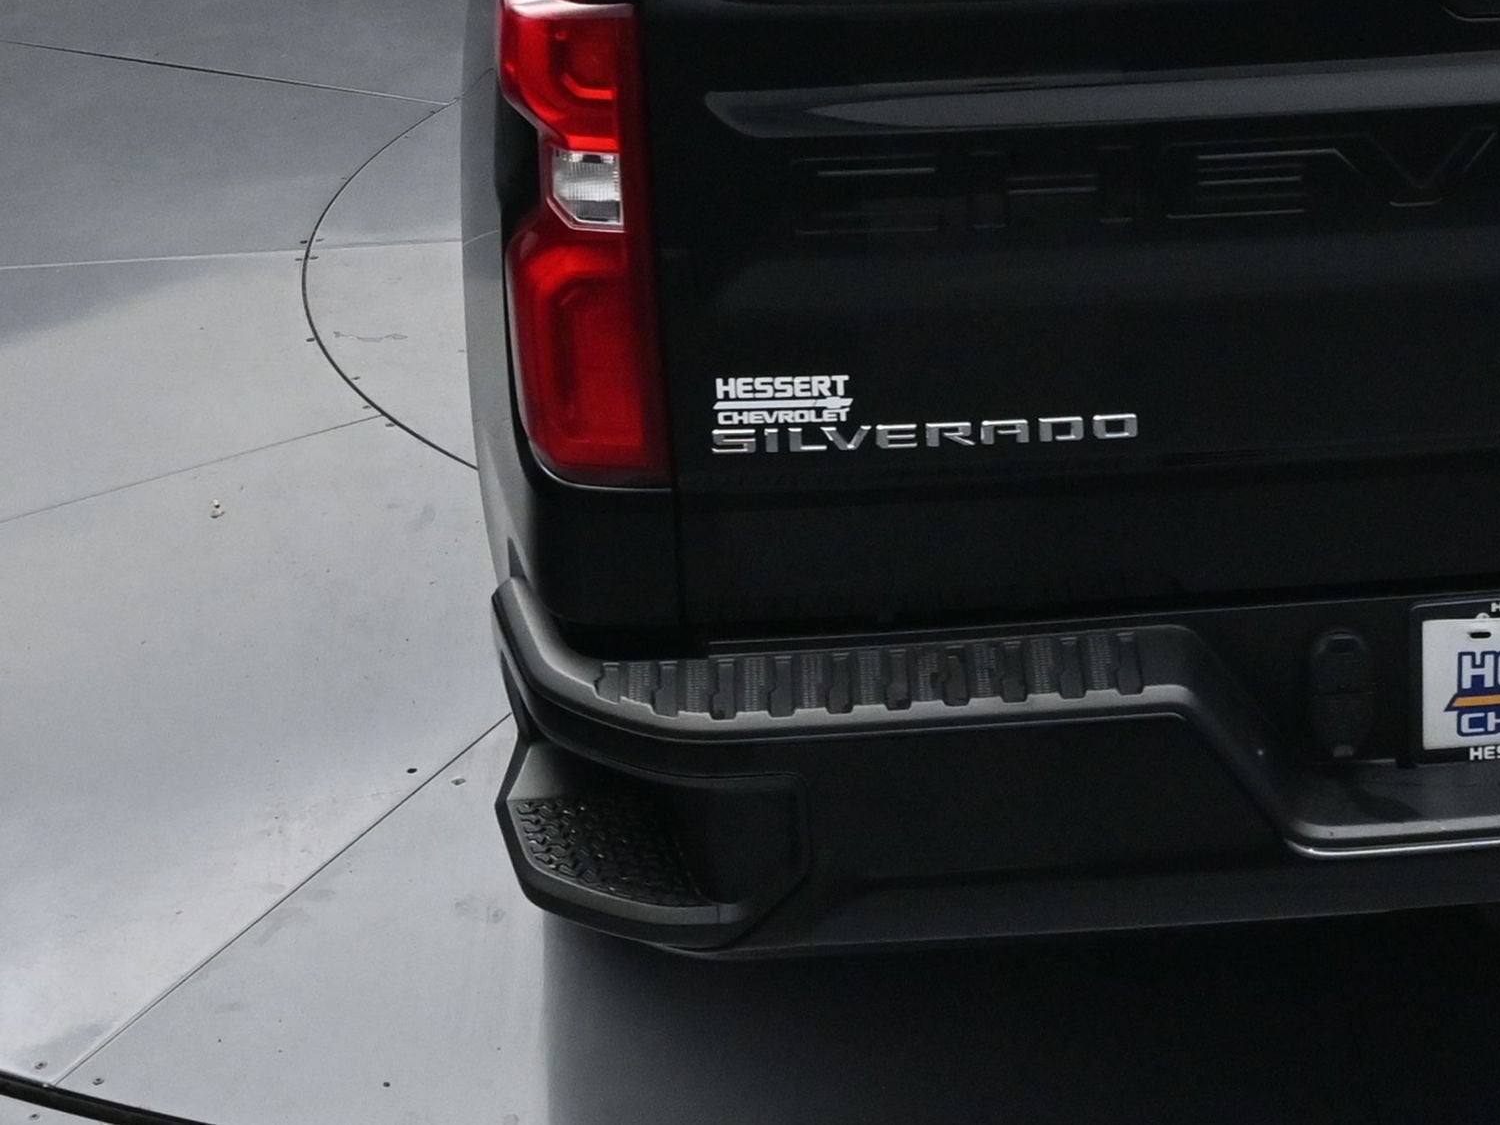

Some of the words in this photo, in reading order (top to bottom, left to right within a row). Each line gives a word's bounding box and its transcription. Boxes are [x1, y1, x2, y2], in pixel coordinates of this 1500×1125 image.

[715, 375, 850, 399] HESSERT
[716, 407, 851, 425] CHEVROLET
[711, 413, 1138, 454] SILVERADO
